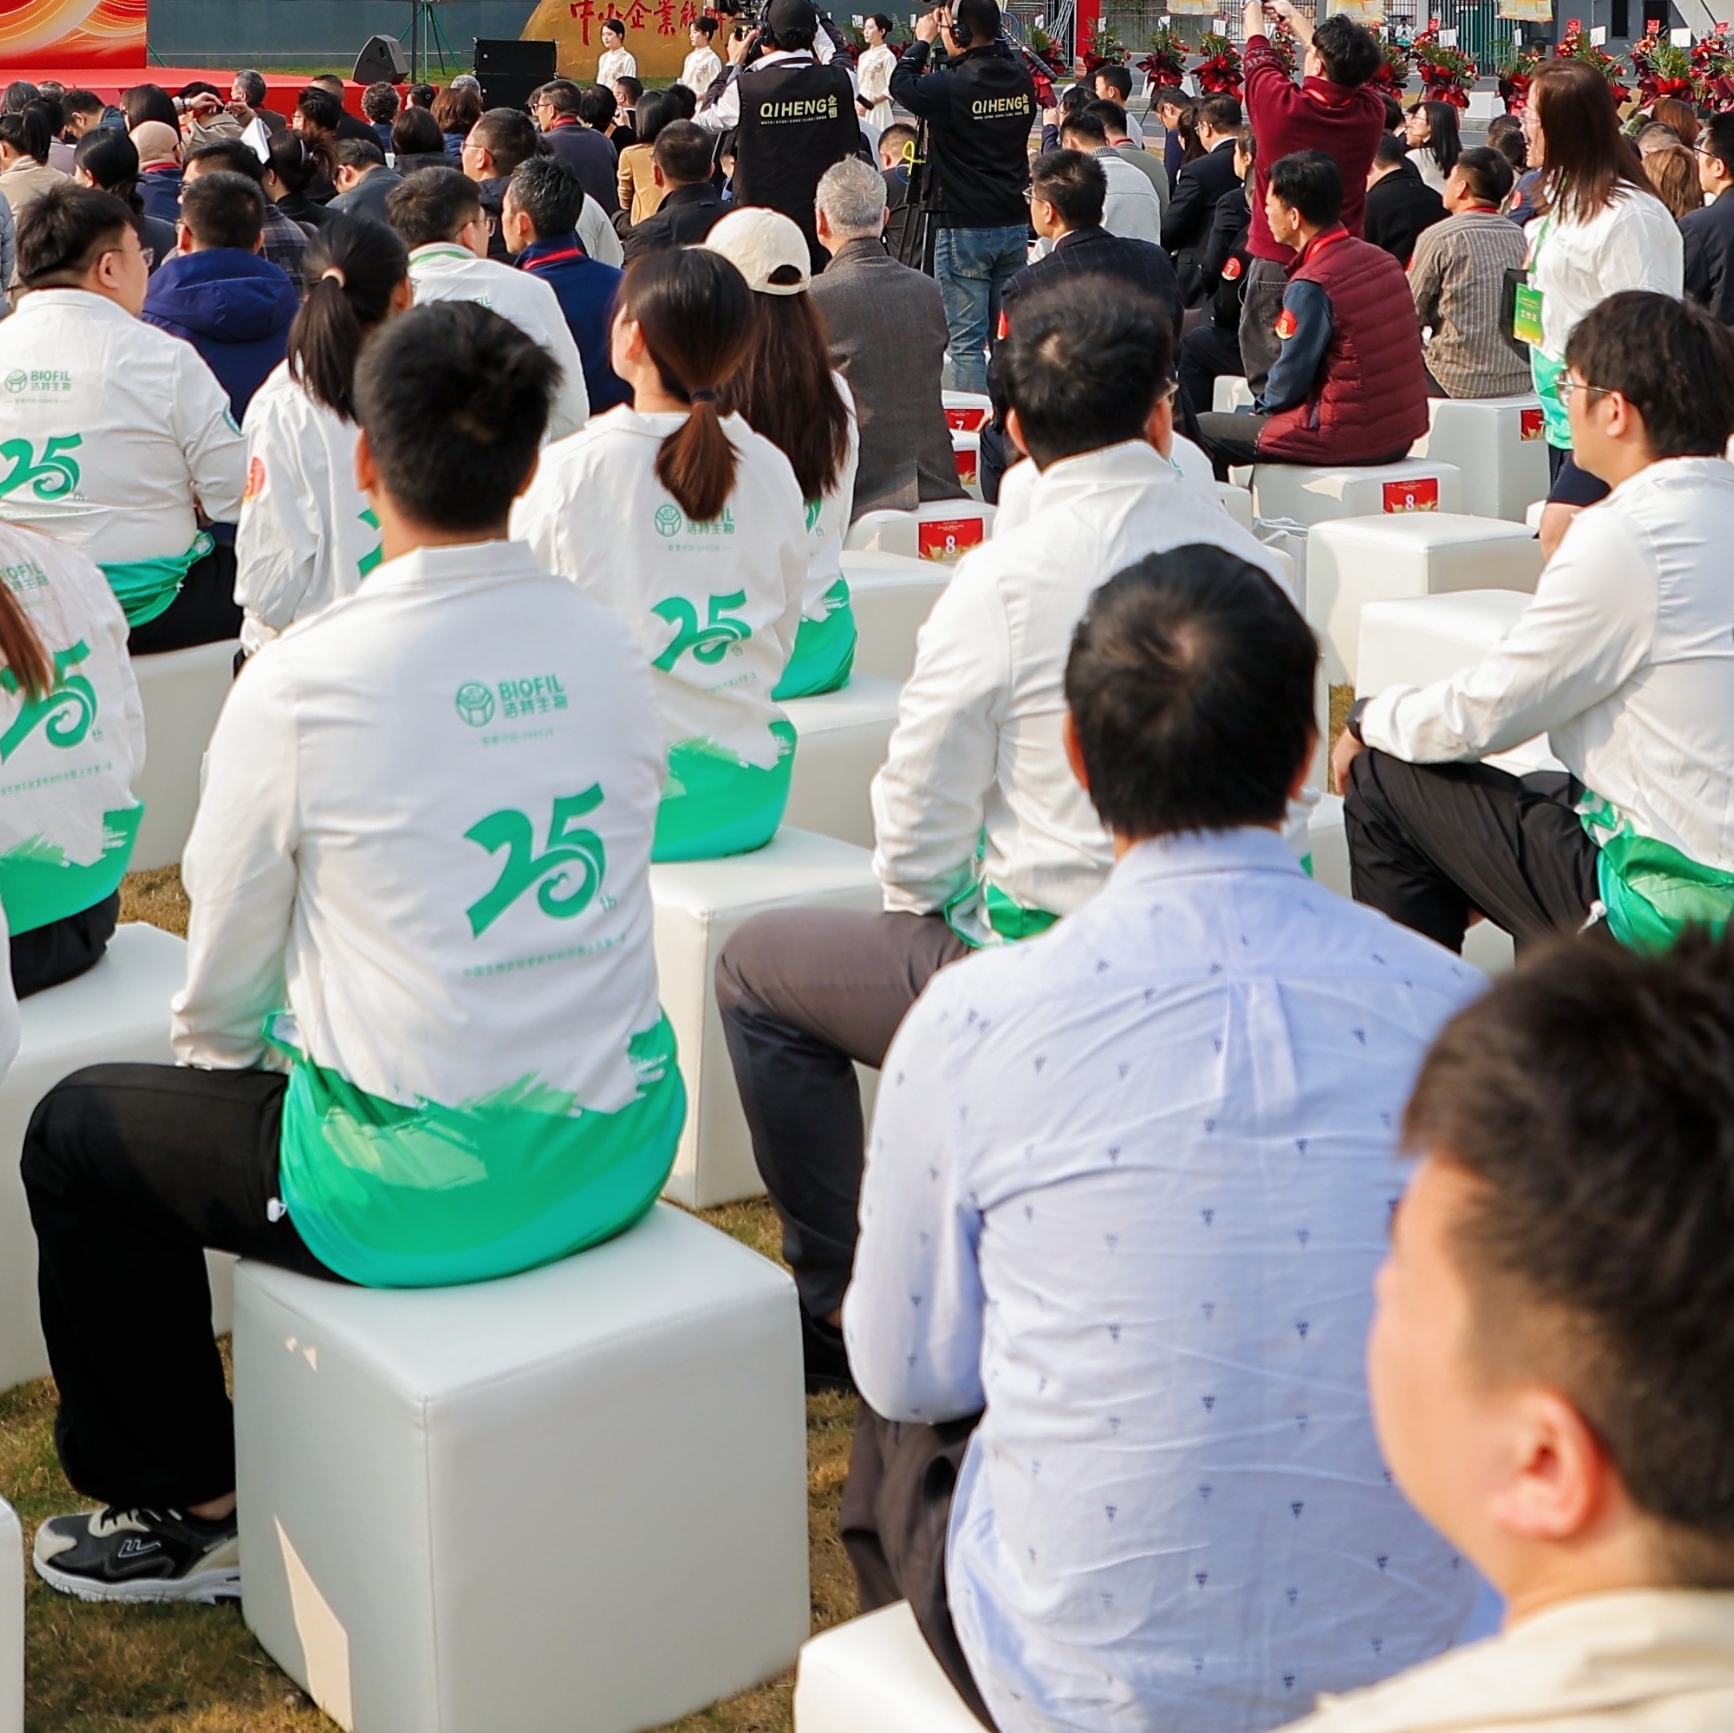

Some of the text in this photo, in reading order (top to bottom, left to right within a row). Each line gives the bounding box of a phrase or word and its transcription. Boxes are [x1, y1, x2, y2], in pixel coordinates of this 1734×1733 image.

[759, 98, 828, 119] QIHENG
[971, 96, 1023, 114] QIHENG
[30, 370, 71, 382] BIOFIL
[955, 420, 965, 430] 7
[1405, 493, 1414, 510] 8
[945, 534, 956, 554] 8
[497, 674, 566, 702] BIOFIL
